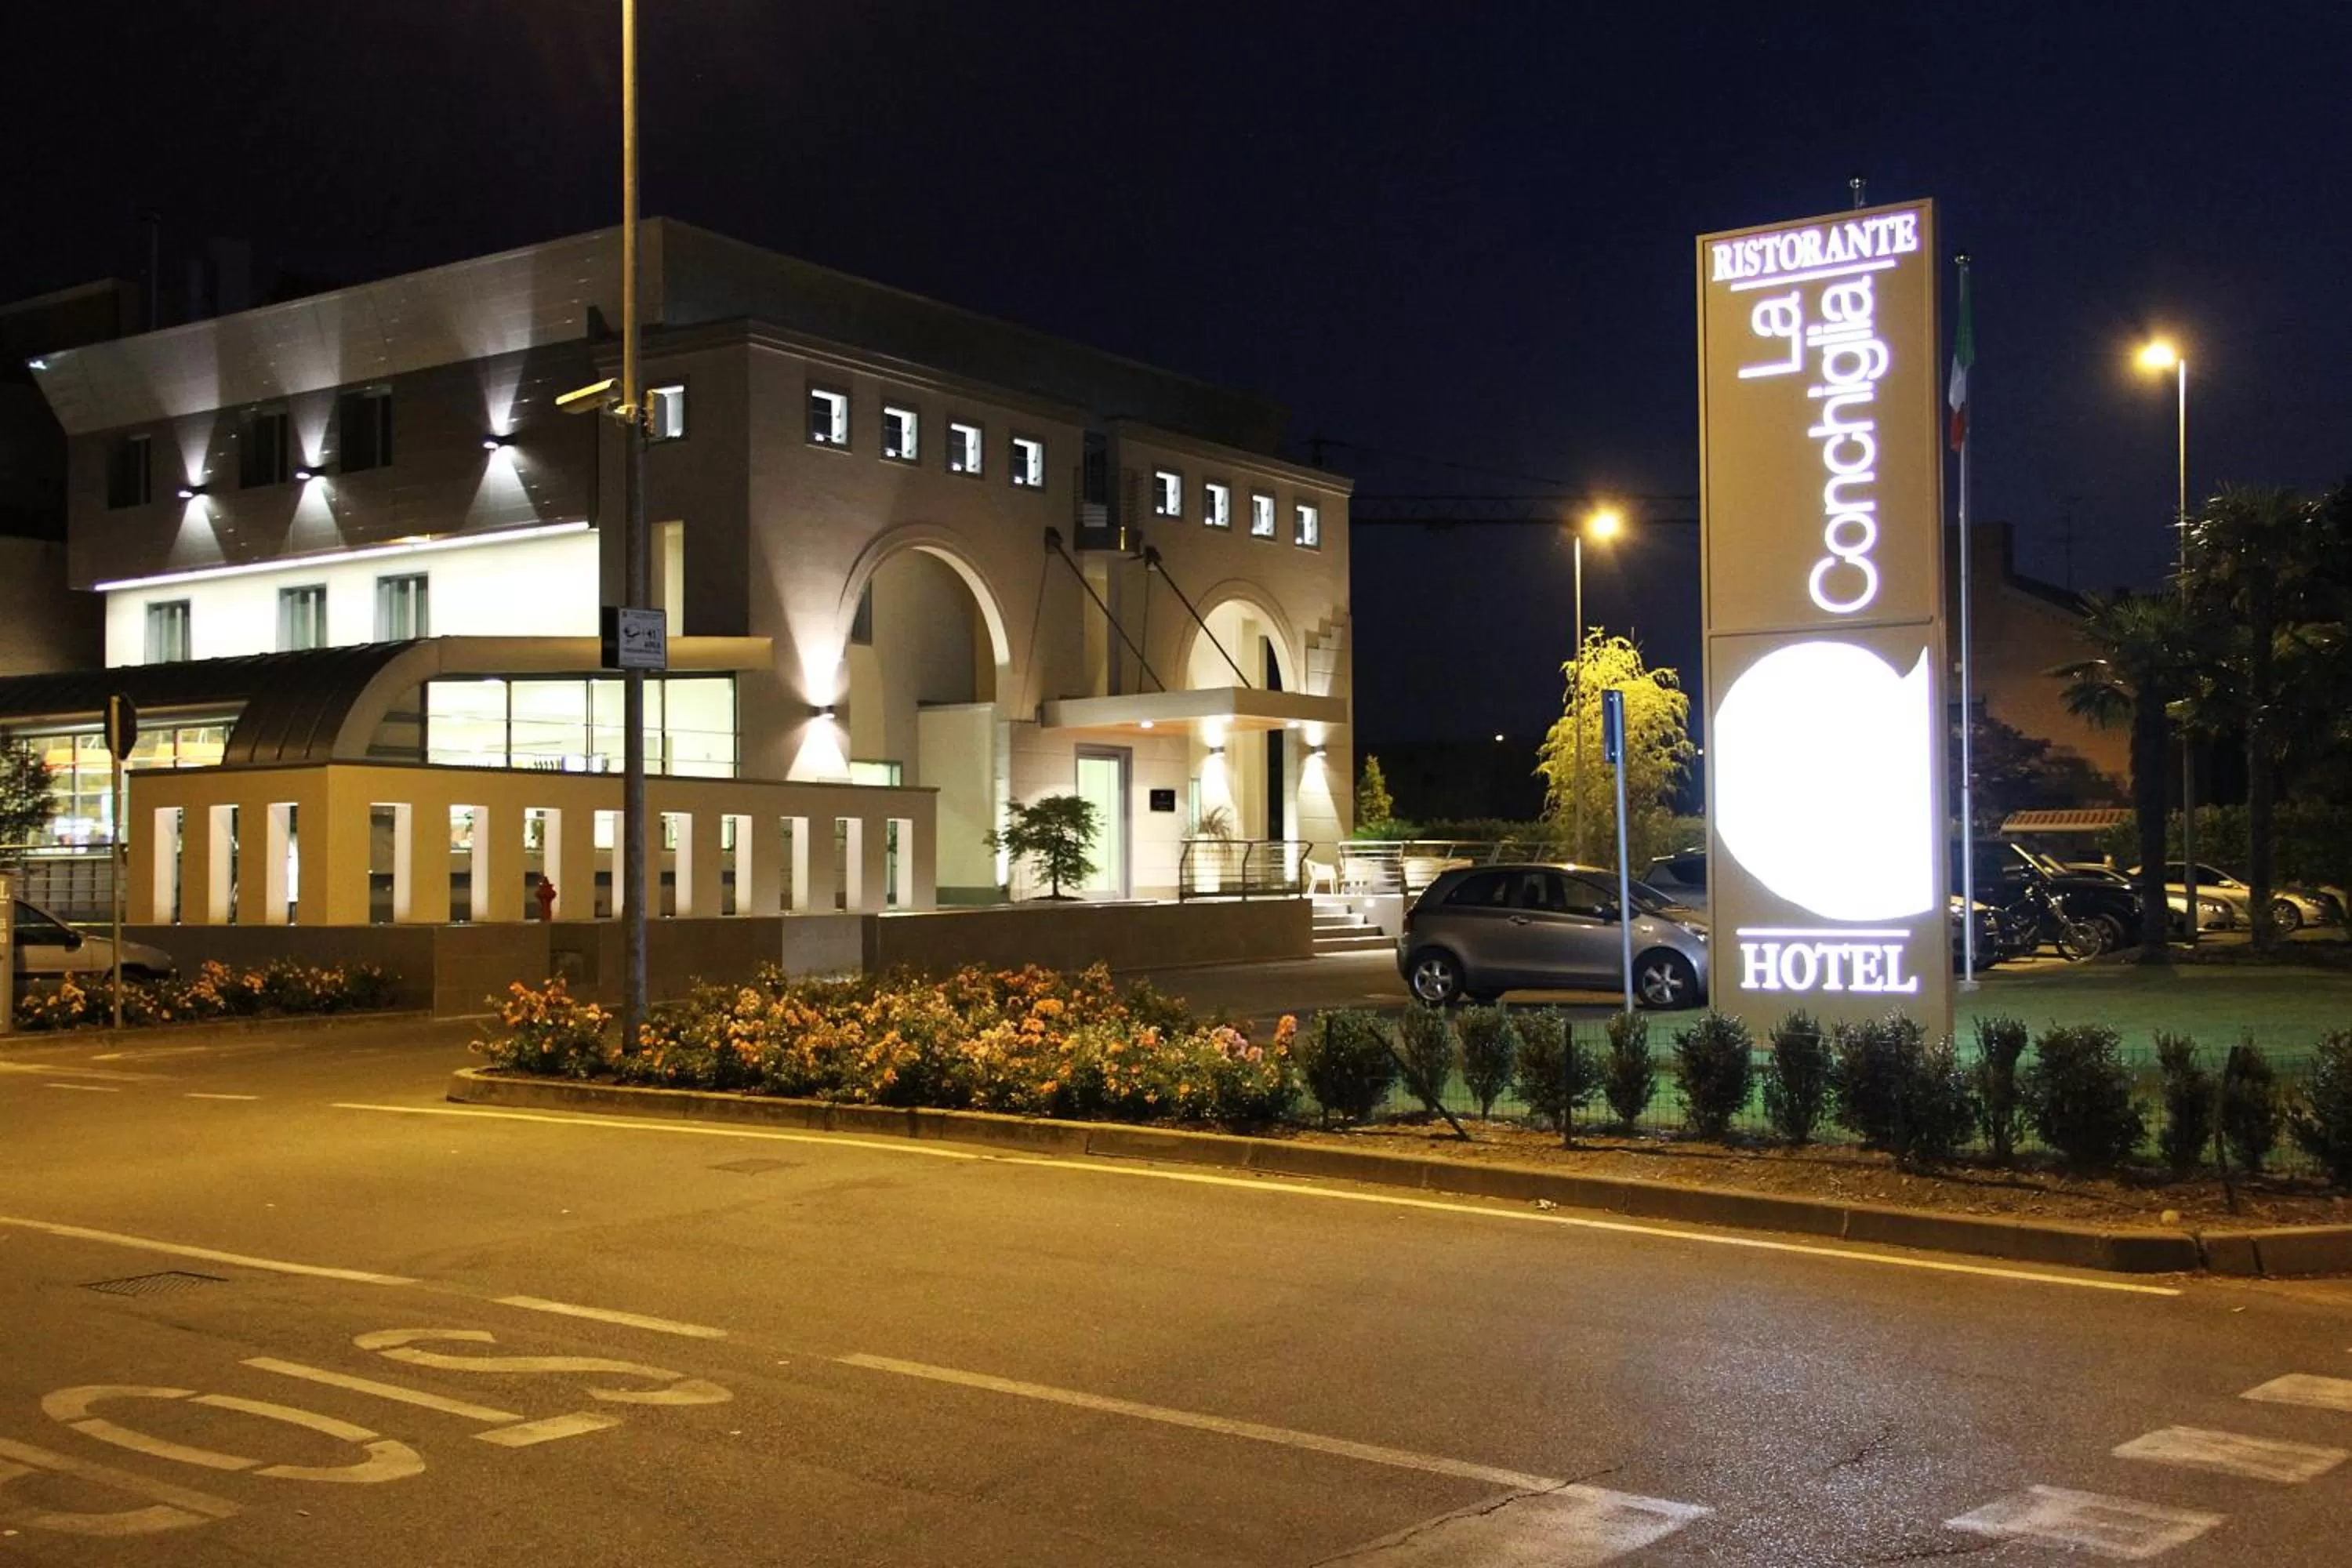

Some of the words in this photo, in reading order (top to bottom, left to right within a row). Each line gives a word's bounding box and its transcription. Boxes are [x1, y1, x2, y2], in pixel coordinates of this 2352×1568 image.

[1711, 213, 1918, 282] RISTORANTE
[1737, 290, 1802, 379] La
[1806, 274, 1889, 614] Conchiglia
[1740, 942, 1918, 993] HOTEL
